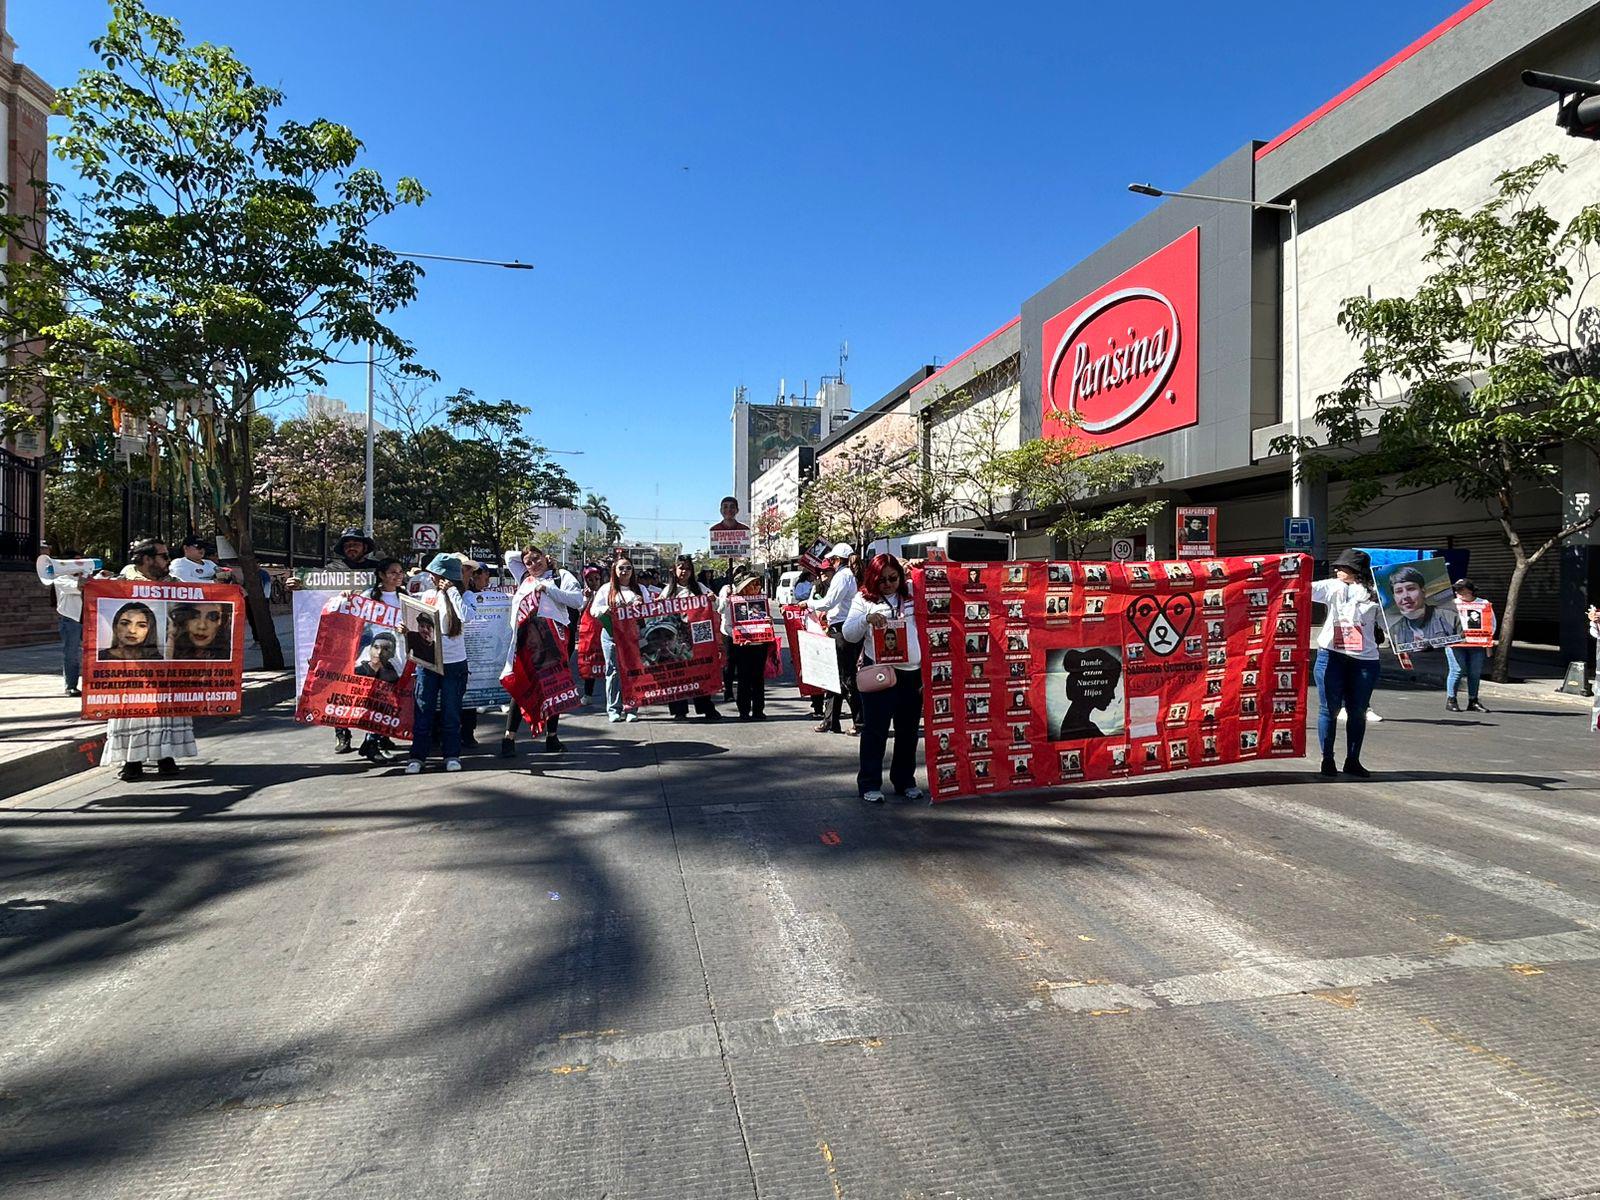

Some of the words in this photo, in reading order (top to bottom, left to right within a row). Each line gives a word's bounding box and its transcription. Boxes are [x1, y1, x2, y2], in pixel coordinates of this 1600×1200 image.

[1069, 326, 1169, 410] Parisina
[1117, 544, 1128, 553] 30
[305, 570, 351, 586] ¿DÓNDE
[354, 571, 377, 586] EST
[131, 585, 204, 600] JUSTICIA
[617, 594, 709, 621] DESAPARECIDO
[1081, 659, 1103, 667] Donde
[644, 682, 699, 698] 6671571930
[1084, 689, 1102, 697] Hijos
[87, 694, 121, 705] MAYRA
[122, 692, 172, 704] GUADALUPE
[173, 692, 204, 702] MILLAN
[205, 691, 237, 701] CASTRO
[327, 692, 356, 706] JESUS
